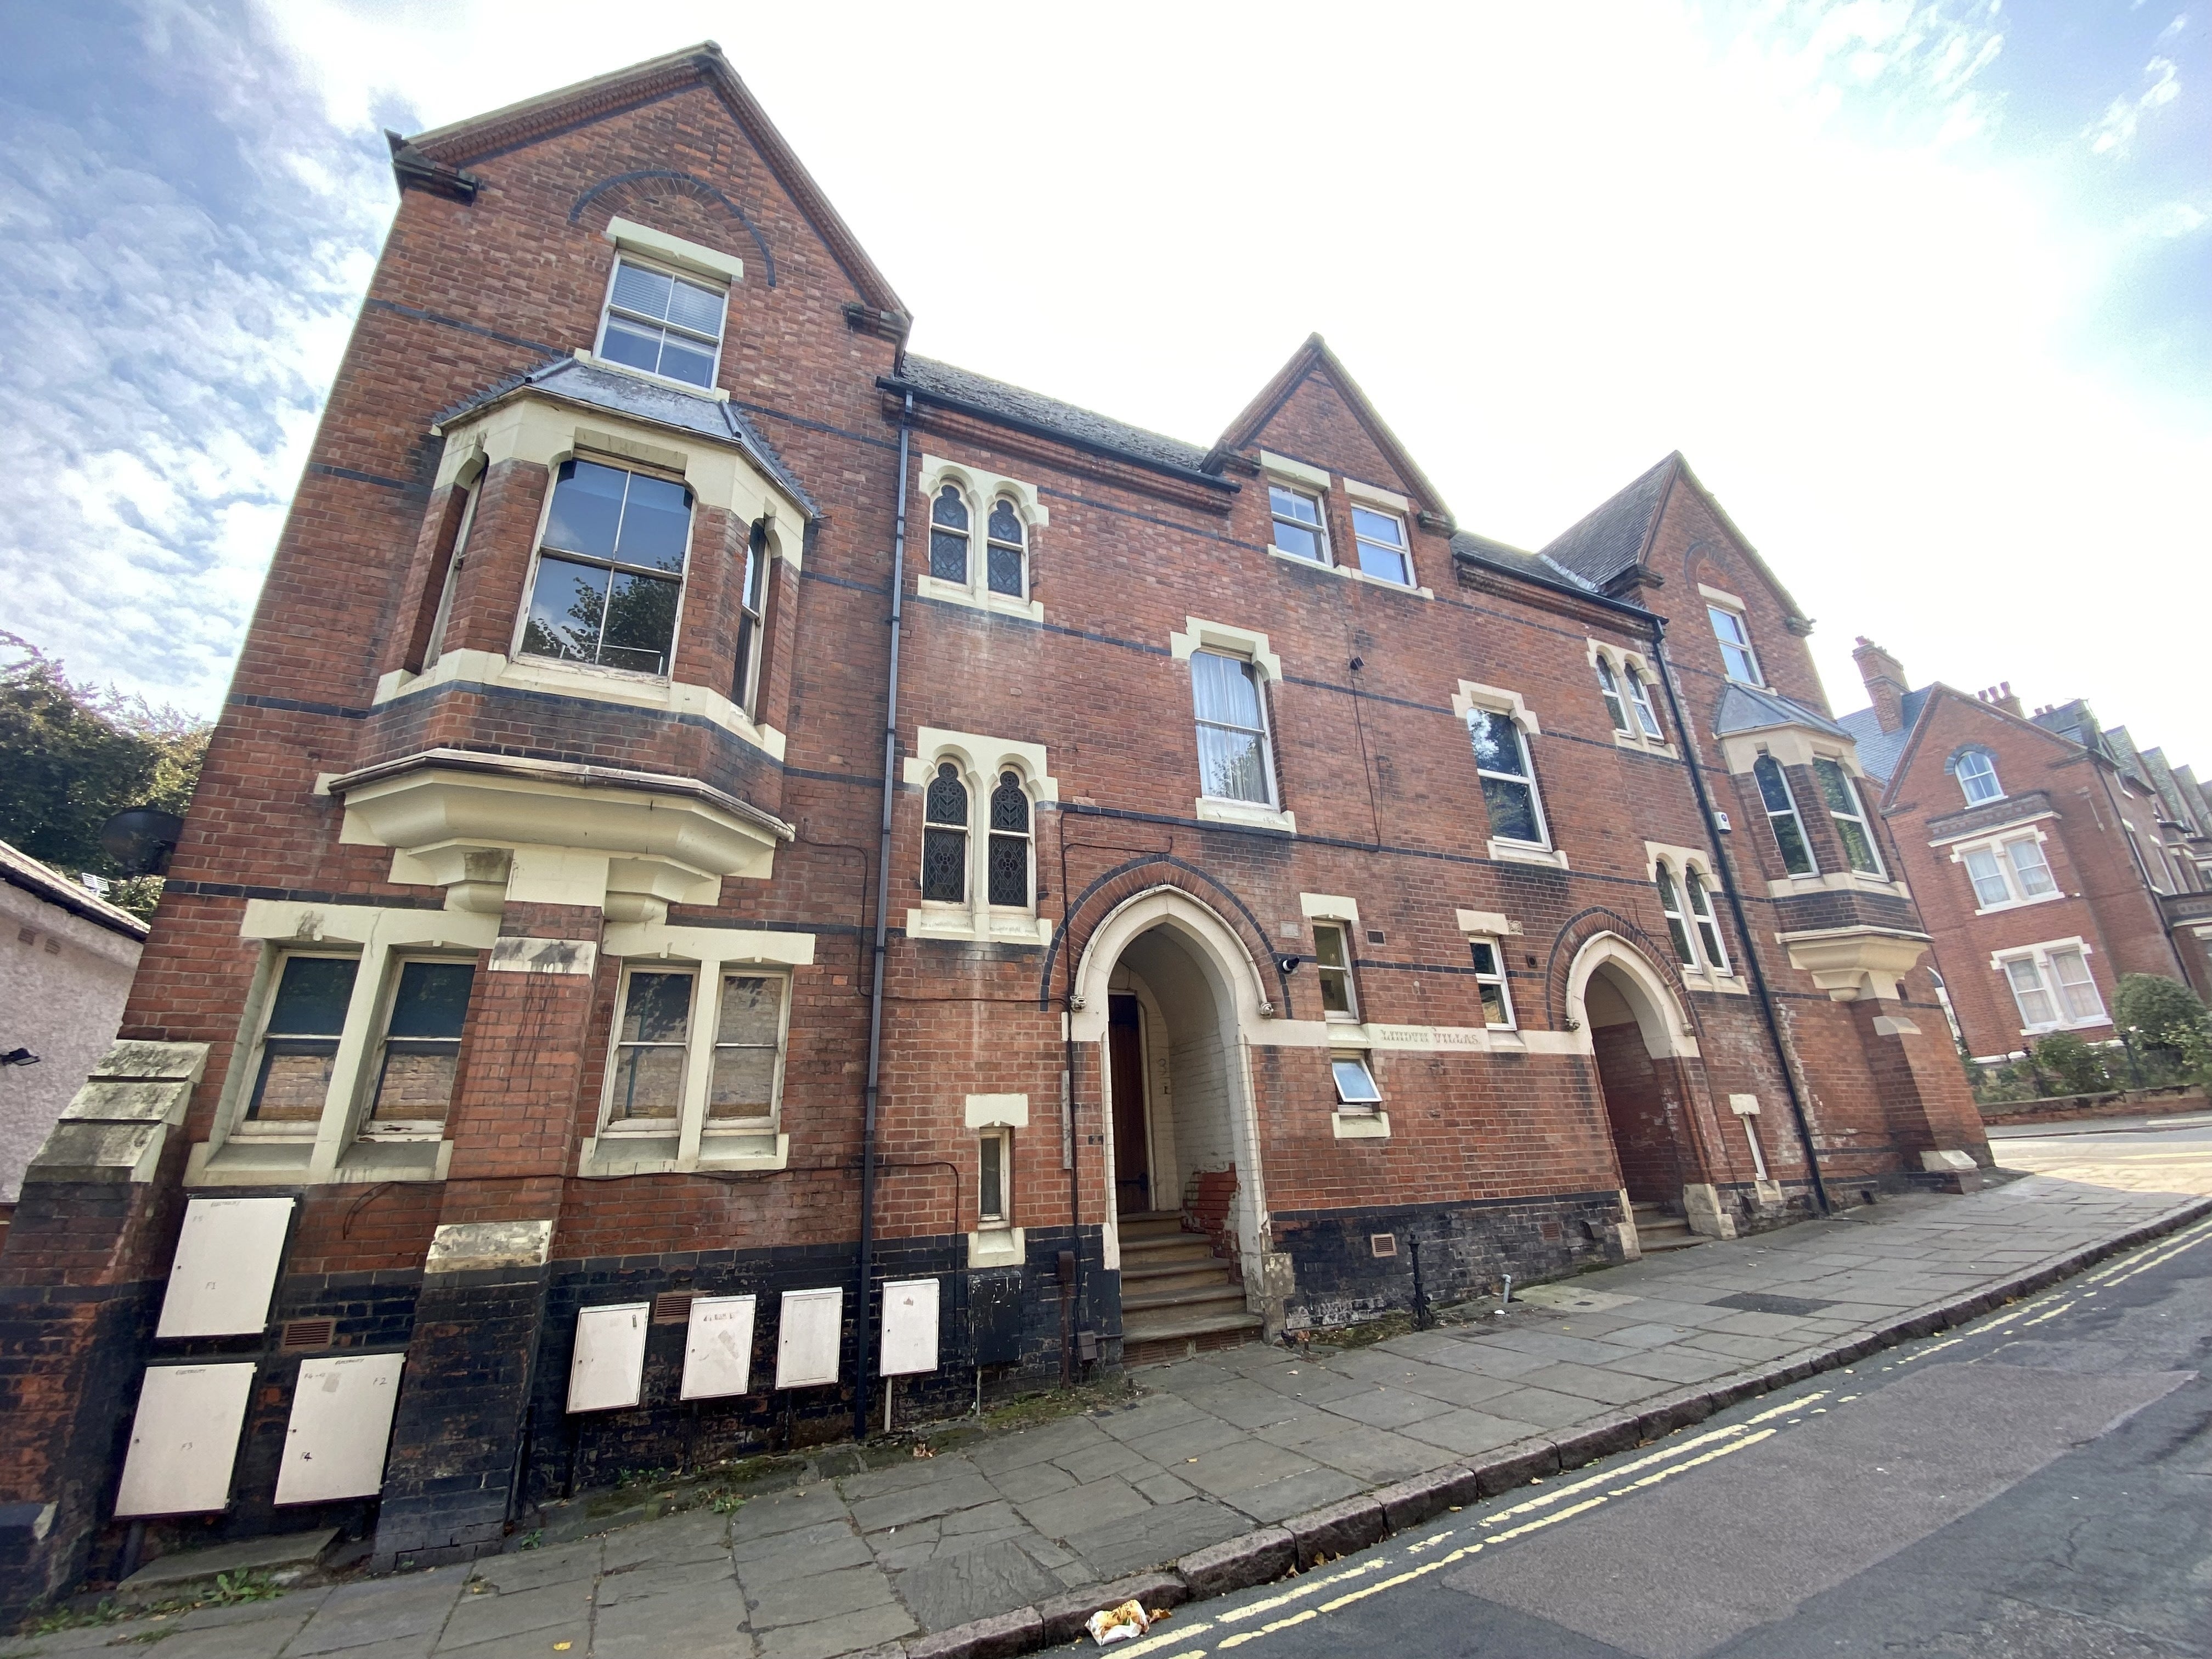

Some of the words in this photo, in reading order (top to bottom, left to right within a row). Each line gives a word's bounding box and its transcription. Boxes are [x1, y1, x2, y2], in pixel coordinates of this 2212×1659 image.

[373, 1376, 387, 1386] F2
[180, 1441, 193, 1452] F3
[300, 1451, 313, 1462] F4
